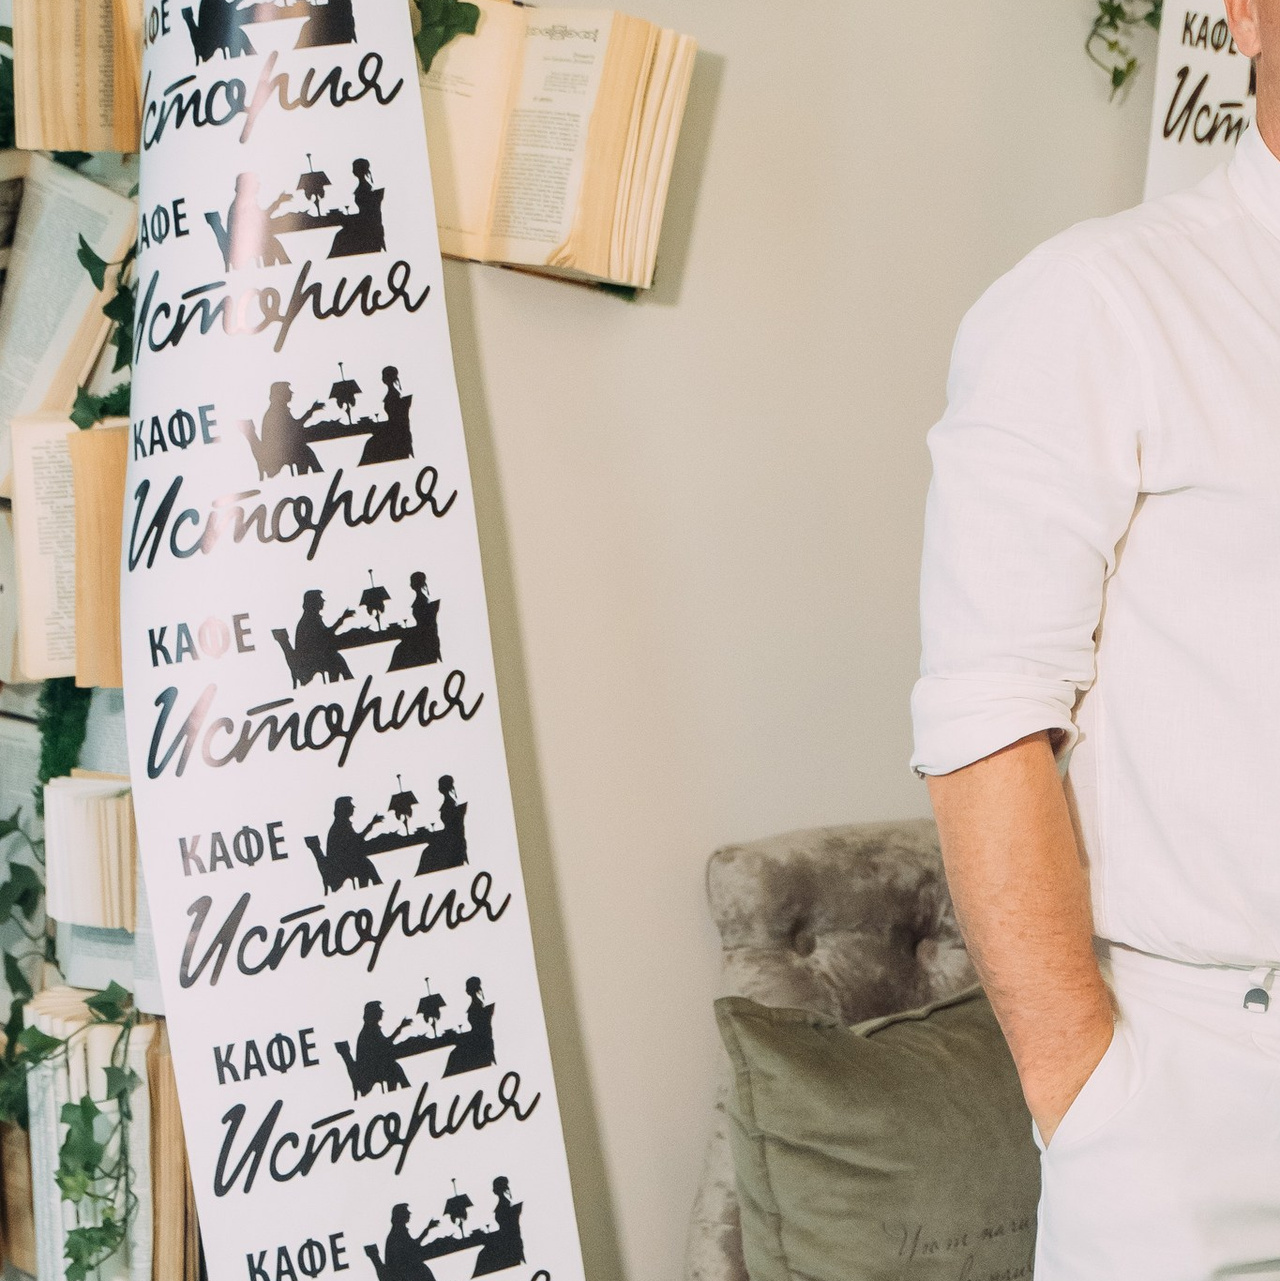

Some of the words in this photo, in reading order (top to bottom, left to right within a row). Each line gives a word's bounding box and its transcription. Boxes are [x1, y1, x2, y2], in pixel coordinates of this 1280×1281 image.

[138, 197, 190, 254] АФЕ
[133, 404, 221, 462] КАФЕ
[128, 465, 458, 573] История
[147, 612, 255, 669] КАФЕ
[146, 669, 485, 780] История
[178, 820, 290, 877] КАФЕ
[179, 871, 512, 990] История
[213, 1026, 320, 1086] КАФЕ
[213, 1070, 541, 1198] История
